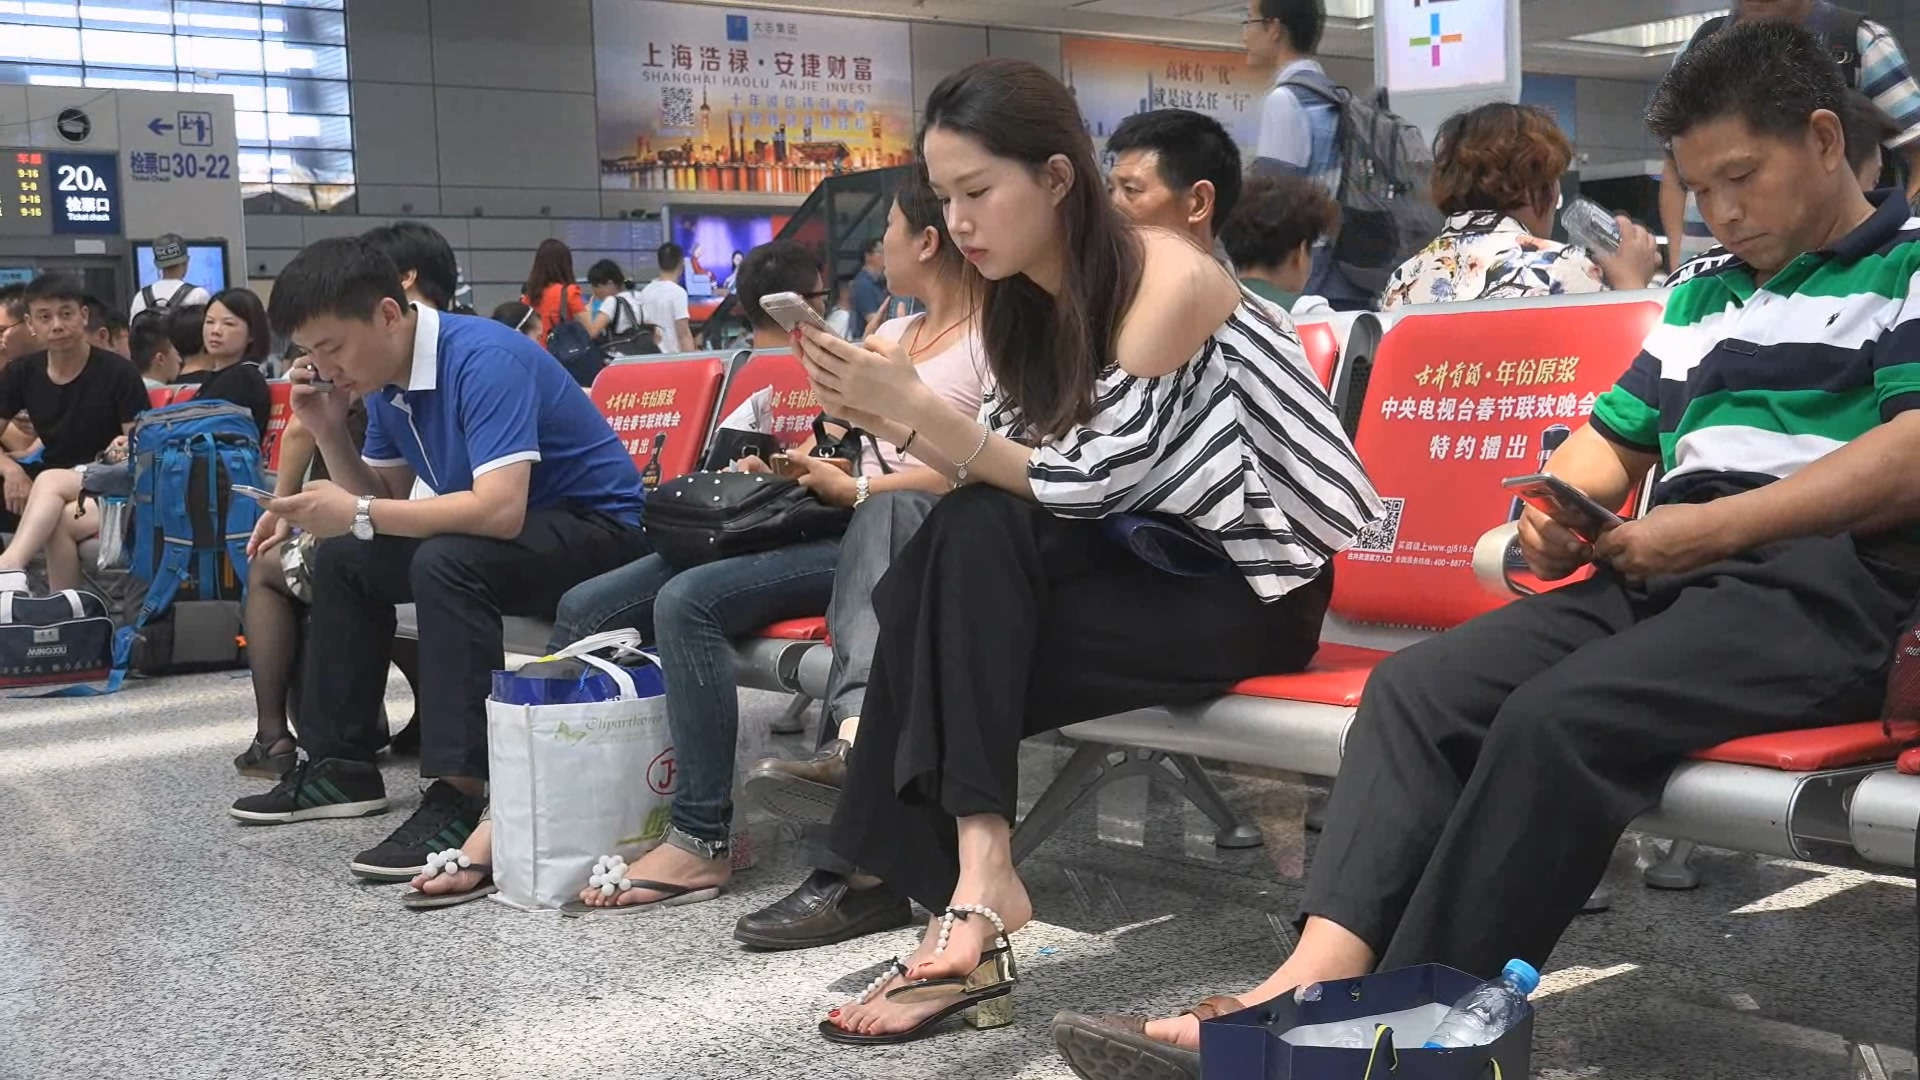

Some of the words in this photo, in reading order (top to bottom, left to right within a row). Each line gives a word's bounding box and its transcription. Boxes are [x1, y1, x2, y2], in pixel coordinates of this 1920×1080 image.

[642, 71, 717, 85] SHANGHAI
[722, 77, 770, 90] HAOLU
[780, 82, 818, 93] ANJIE
[826, 83, 873, 95] INVEST
[57, 165, 107, 192] 20A
[1380, 391, 1595, 423] 中央电视台春节联欢晚会
[1429, 434, 1528, 460] 特约播出
